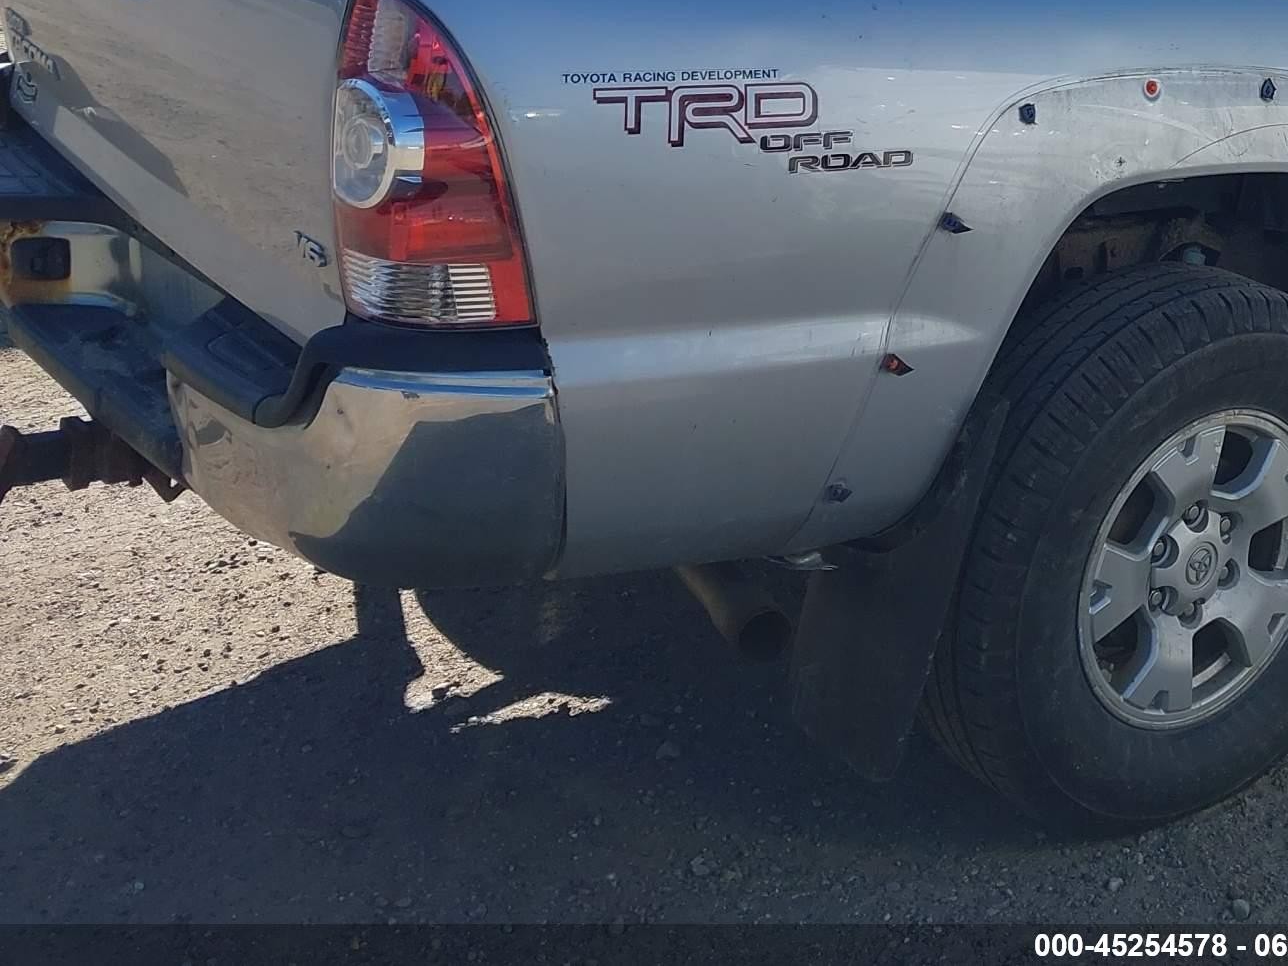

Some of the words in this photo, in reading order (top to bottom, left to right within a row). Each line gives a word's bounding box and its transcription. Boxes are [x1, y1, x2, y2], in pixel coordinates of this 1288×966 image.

[562, 72, 616, 84] TOYOTA
[622, 71, 676, 83] RACING
[681, 68, 779, 81] DEVELOPMENT
[593, 82, 818, 147] TRD
[759, 131, 853, 153] OFF
[788, 149, 914, 174] ROAD
[293, 230, 328, 268] V6
